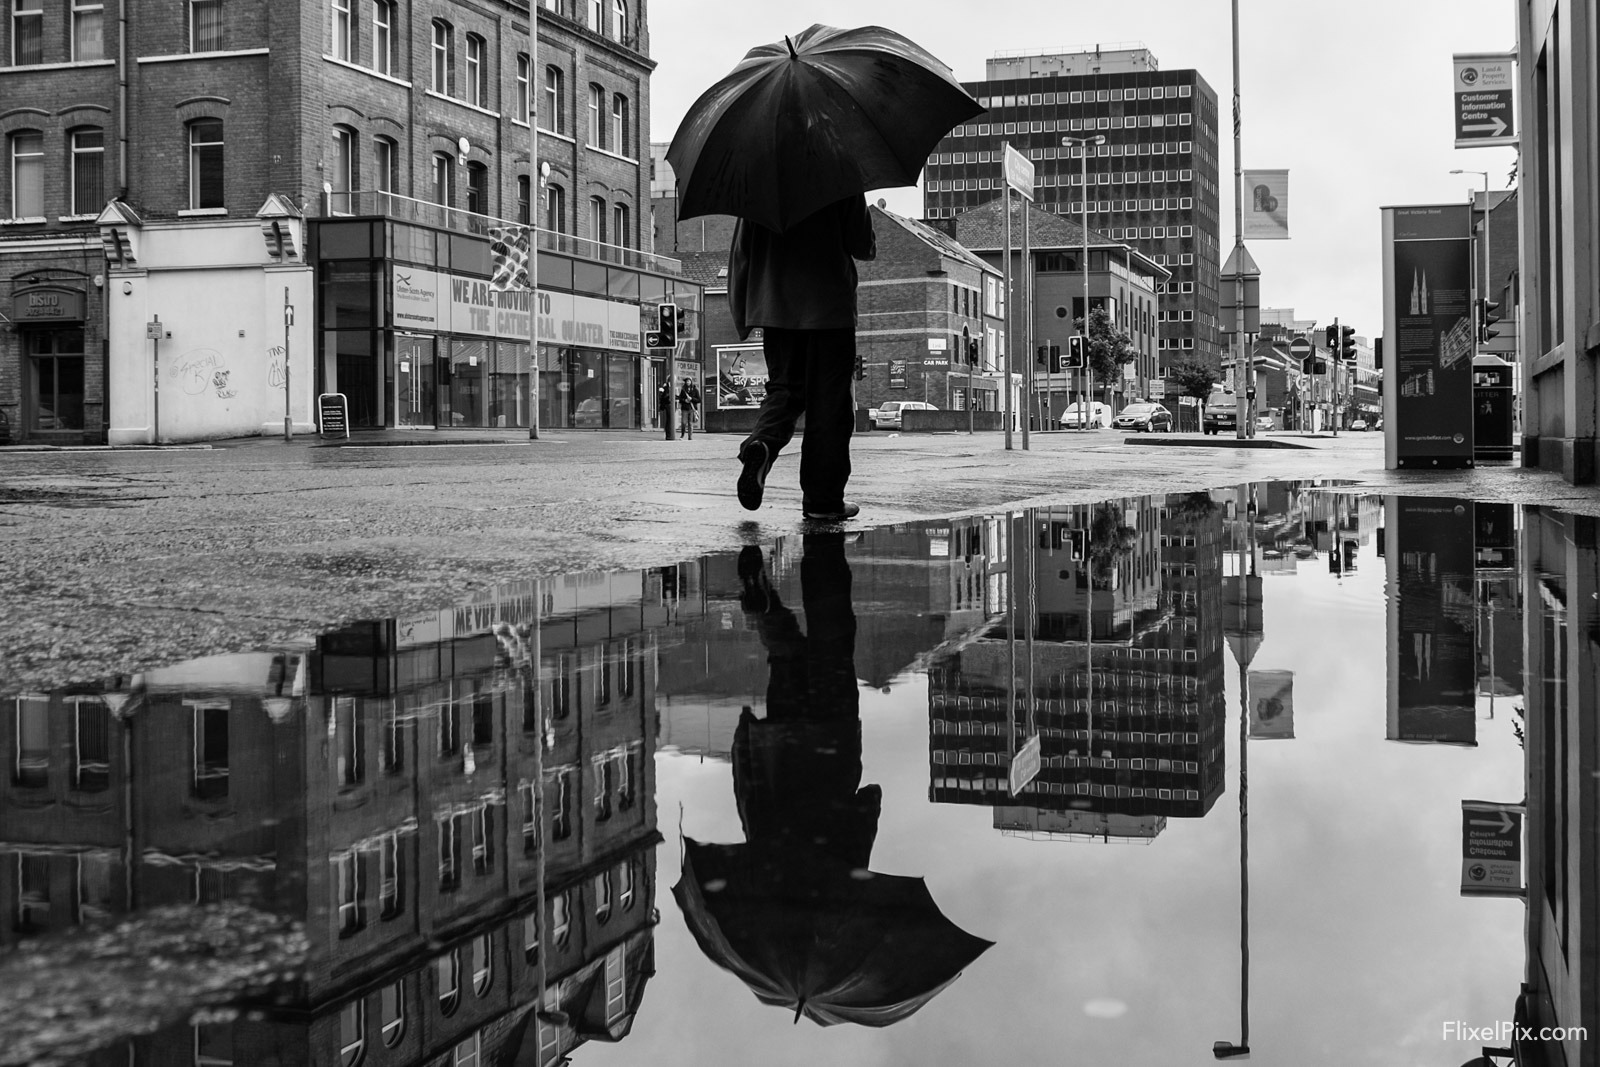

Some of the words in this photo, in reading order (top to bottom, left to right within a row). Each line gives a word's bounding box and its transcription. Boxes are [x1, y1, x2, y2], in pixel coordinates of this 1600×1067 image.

[1462, 102, 1506, 110] Information
[29, 292, 58, 306] bistro
[452, 278, 470, 304] WE
[472, 282, 494, 307] ARE
[498, 290, 533, 312] MOVIN
[538, 292, 551, 315] TO
[469, 307, 490, 332] THE
[498, 311, 557, 340] CATHERAL
[562, 320, 604, 344] QUARTER
